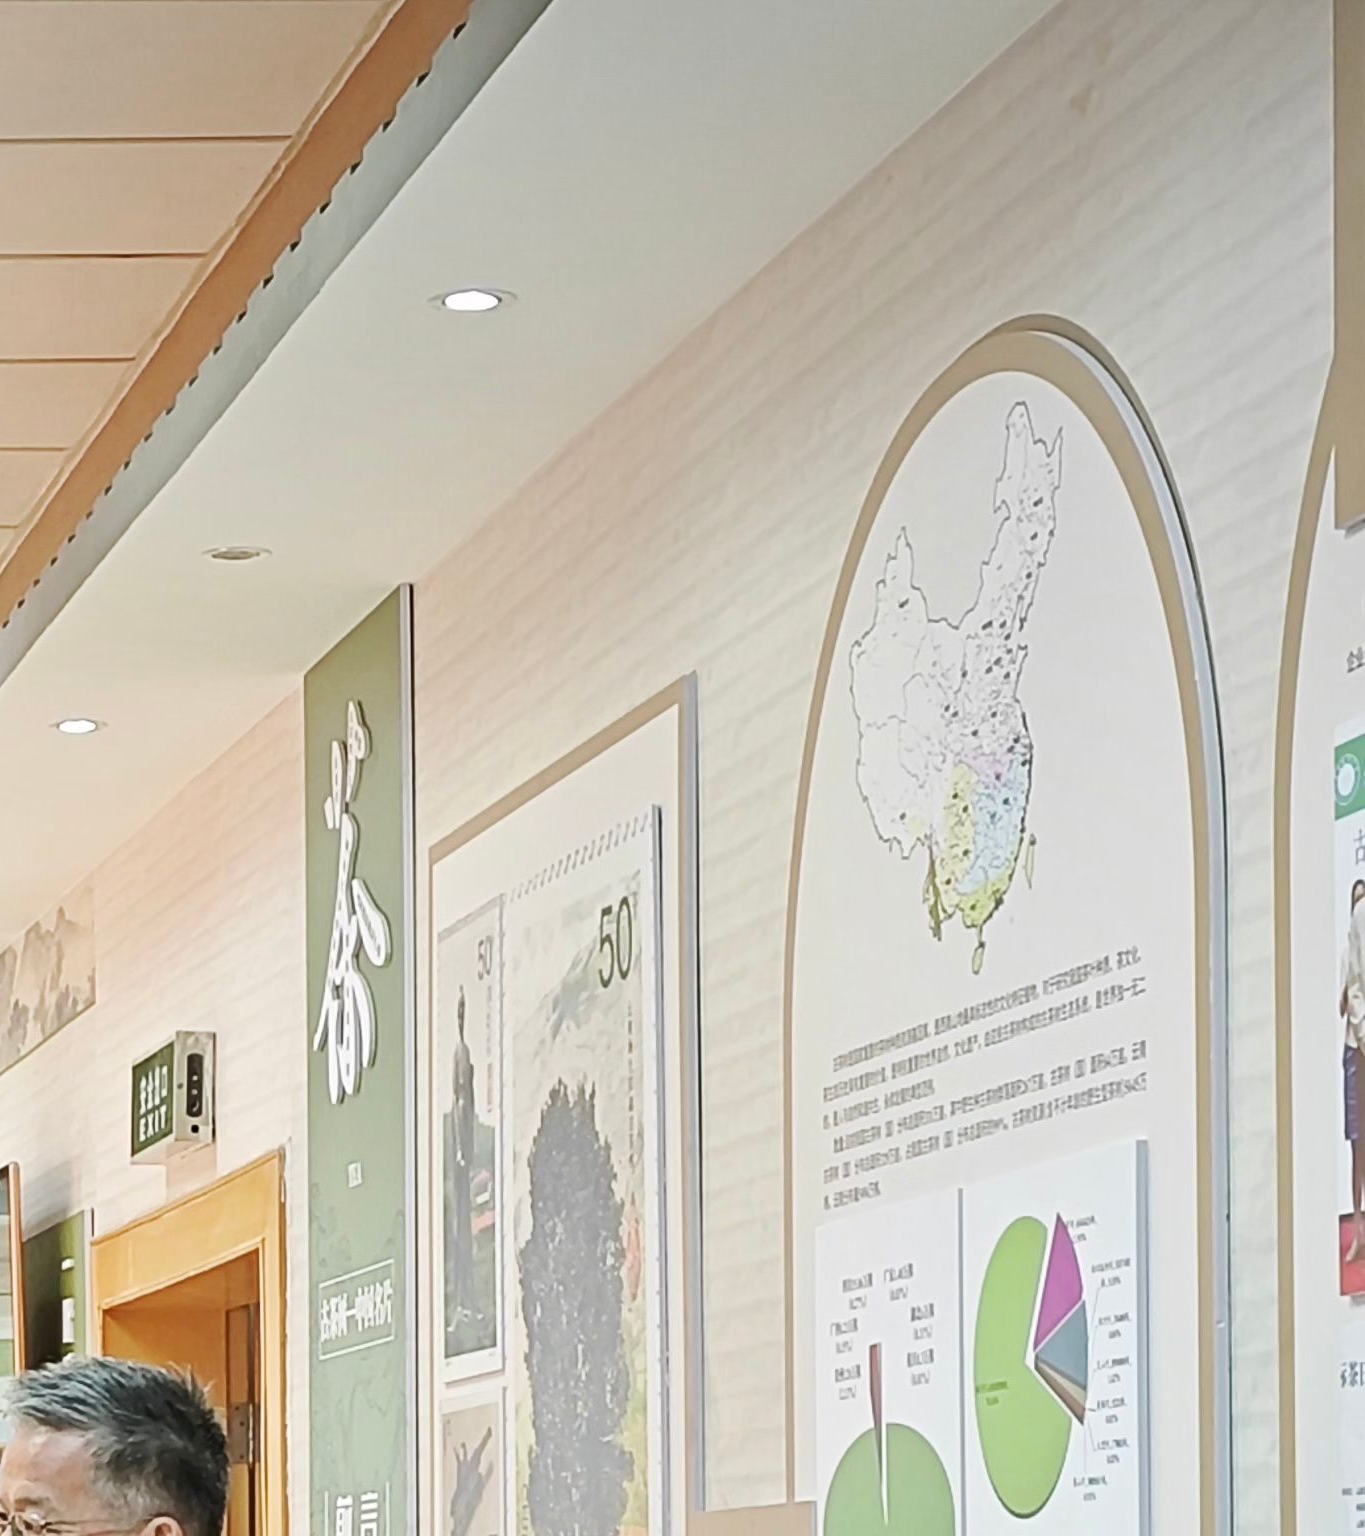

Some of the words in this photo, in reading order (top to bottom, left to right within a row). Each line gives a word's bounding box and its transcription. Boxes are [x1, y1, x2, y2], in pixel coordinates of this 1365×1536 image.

[477, 935, 494, 981] 50
[597, 896, 634, 988] 50
[139, 1104, 167, 1142] EXIT
